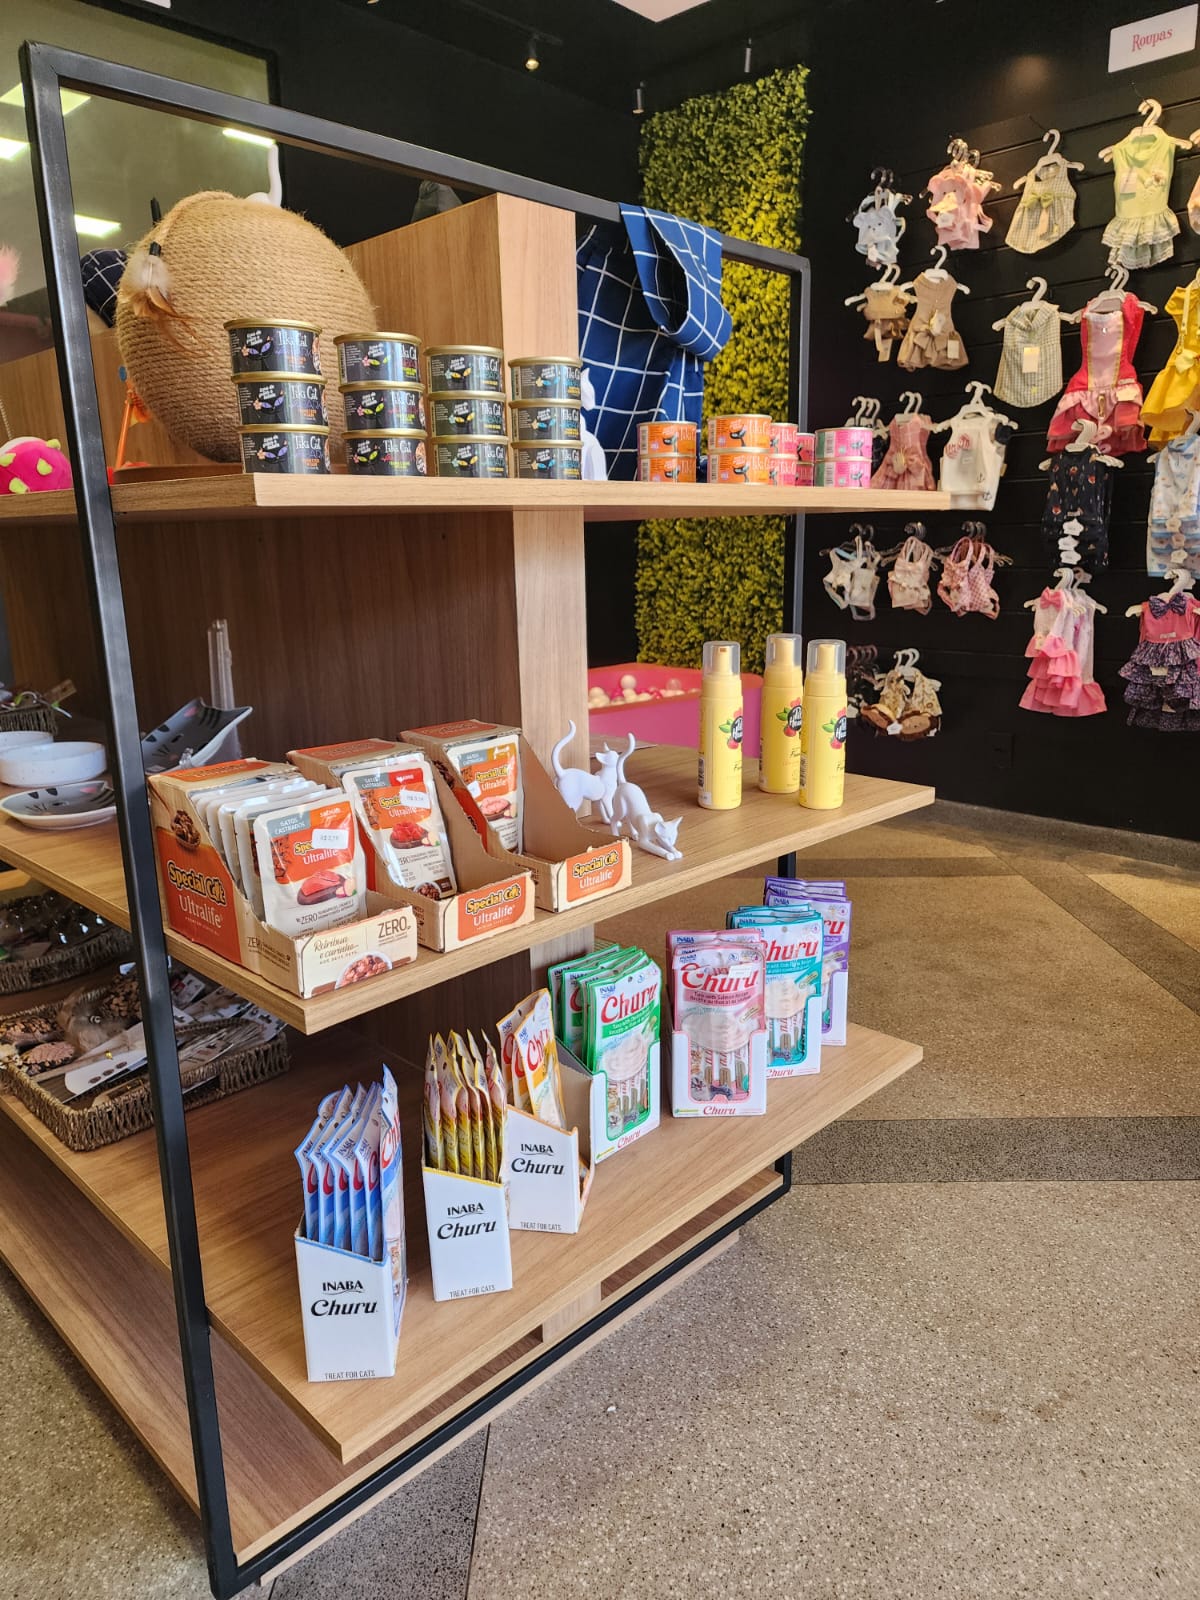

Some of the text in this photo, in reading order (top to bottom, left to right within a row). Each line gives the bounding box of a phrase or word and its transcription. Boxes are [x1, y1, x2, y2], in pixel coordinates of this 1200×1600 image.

[1132, 29, 1173, 52] Roupas
[302, 848, 340, 865] Ultralife
[572, 849, 619, 879] Special Cat
[167, 860, 227, 907] Special Cat
[579, 869, 613, 888] Ultralife
[466, 883, 522, 916] Special Cat
[179, 894, 222, 929] Ultralife
[473, 905, 513, 926] Ultralife
[377, 916, 408, 939] ZERO
[680, 962, 759, 993] Churu
[601, 983, 658, 1024] Churu
[703, 1106, 736, 1115] Churu
[617, 1130, 641, 1148] Churu
[520, 1143, 554, 1154] INABA
[511, 1157, 565, 1175] Churu
[447, 1202, 485, 1216] INABA
[437, 1220, 497, 1240] Churu
[520, 1221, 536, 1229] TREAT
[537, 1222, 547, 1230] FOR
[322, 1280, 364, 1292] INABA
[450, 1290, 467, 1299] TREAT
[481, 1284, 496, 1293] CATS
[310, 1299, 378, 1317] Churu
[325, 1372, 344, 1380] TREAT
[359, 1370, 376, 1378] CATS
